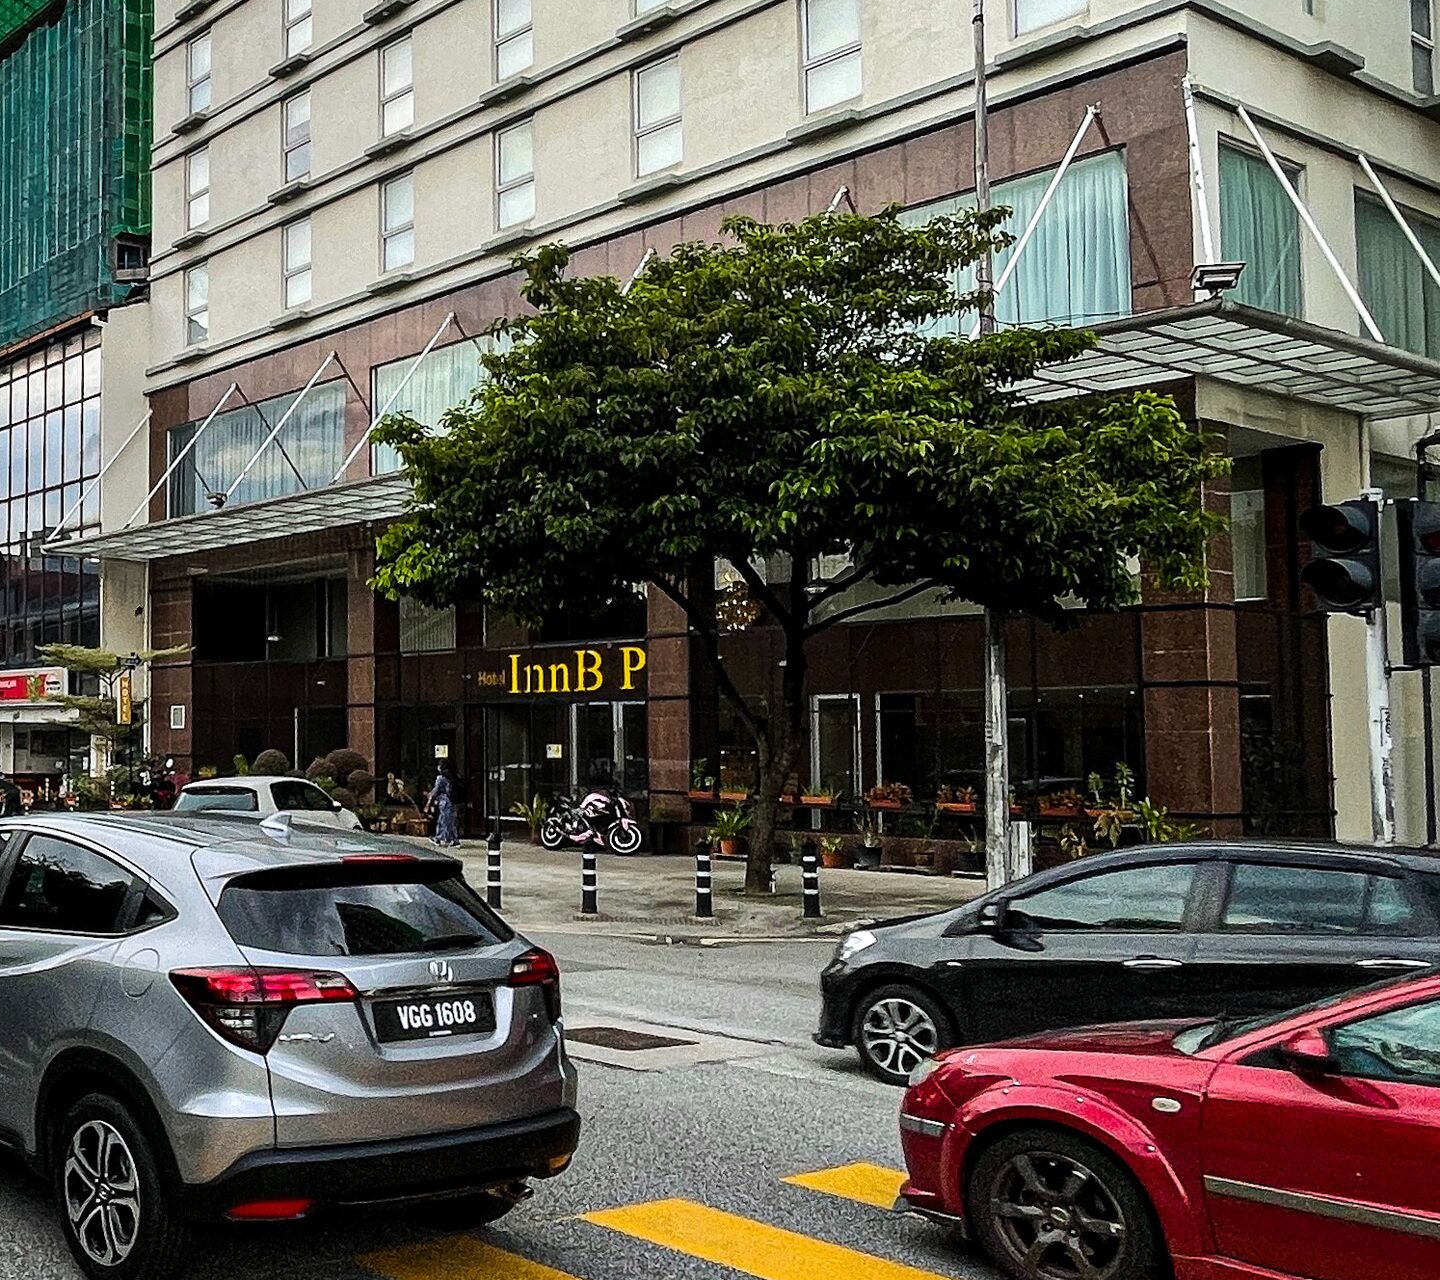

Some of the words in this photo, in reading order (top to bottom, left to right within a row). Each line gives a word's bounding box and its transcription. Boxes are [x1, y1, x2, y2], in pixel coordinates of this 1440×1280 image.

[121, 680, 129, 721] HOTEL
[397, 1003, 433, 1030] VGG
[435, 1000, 476, 1028] 1608
